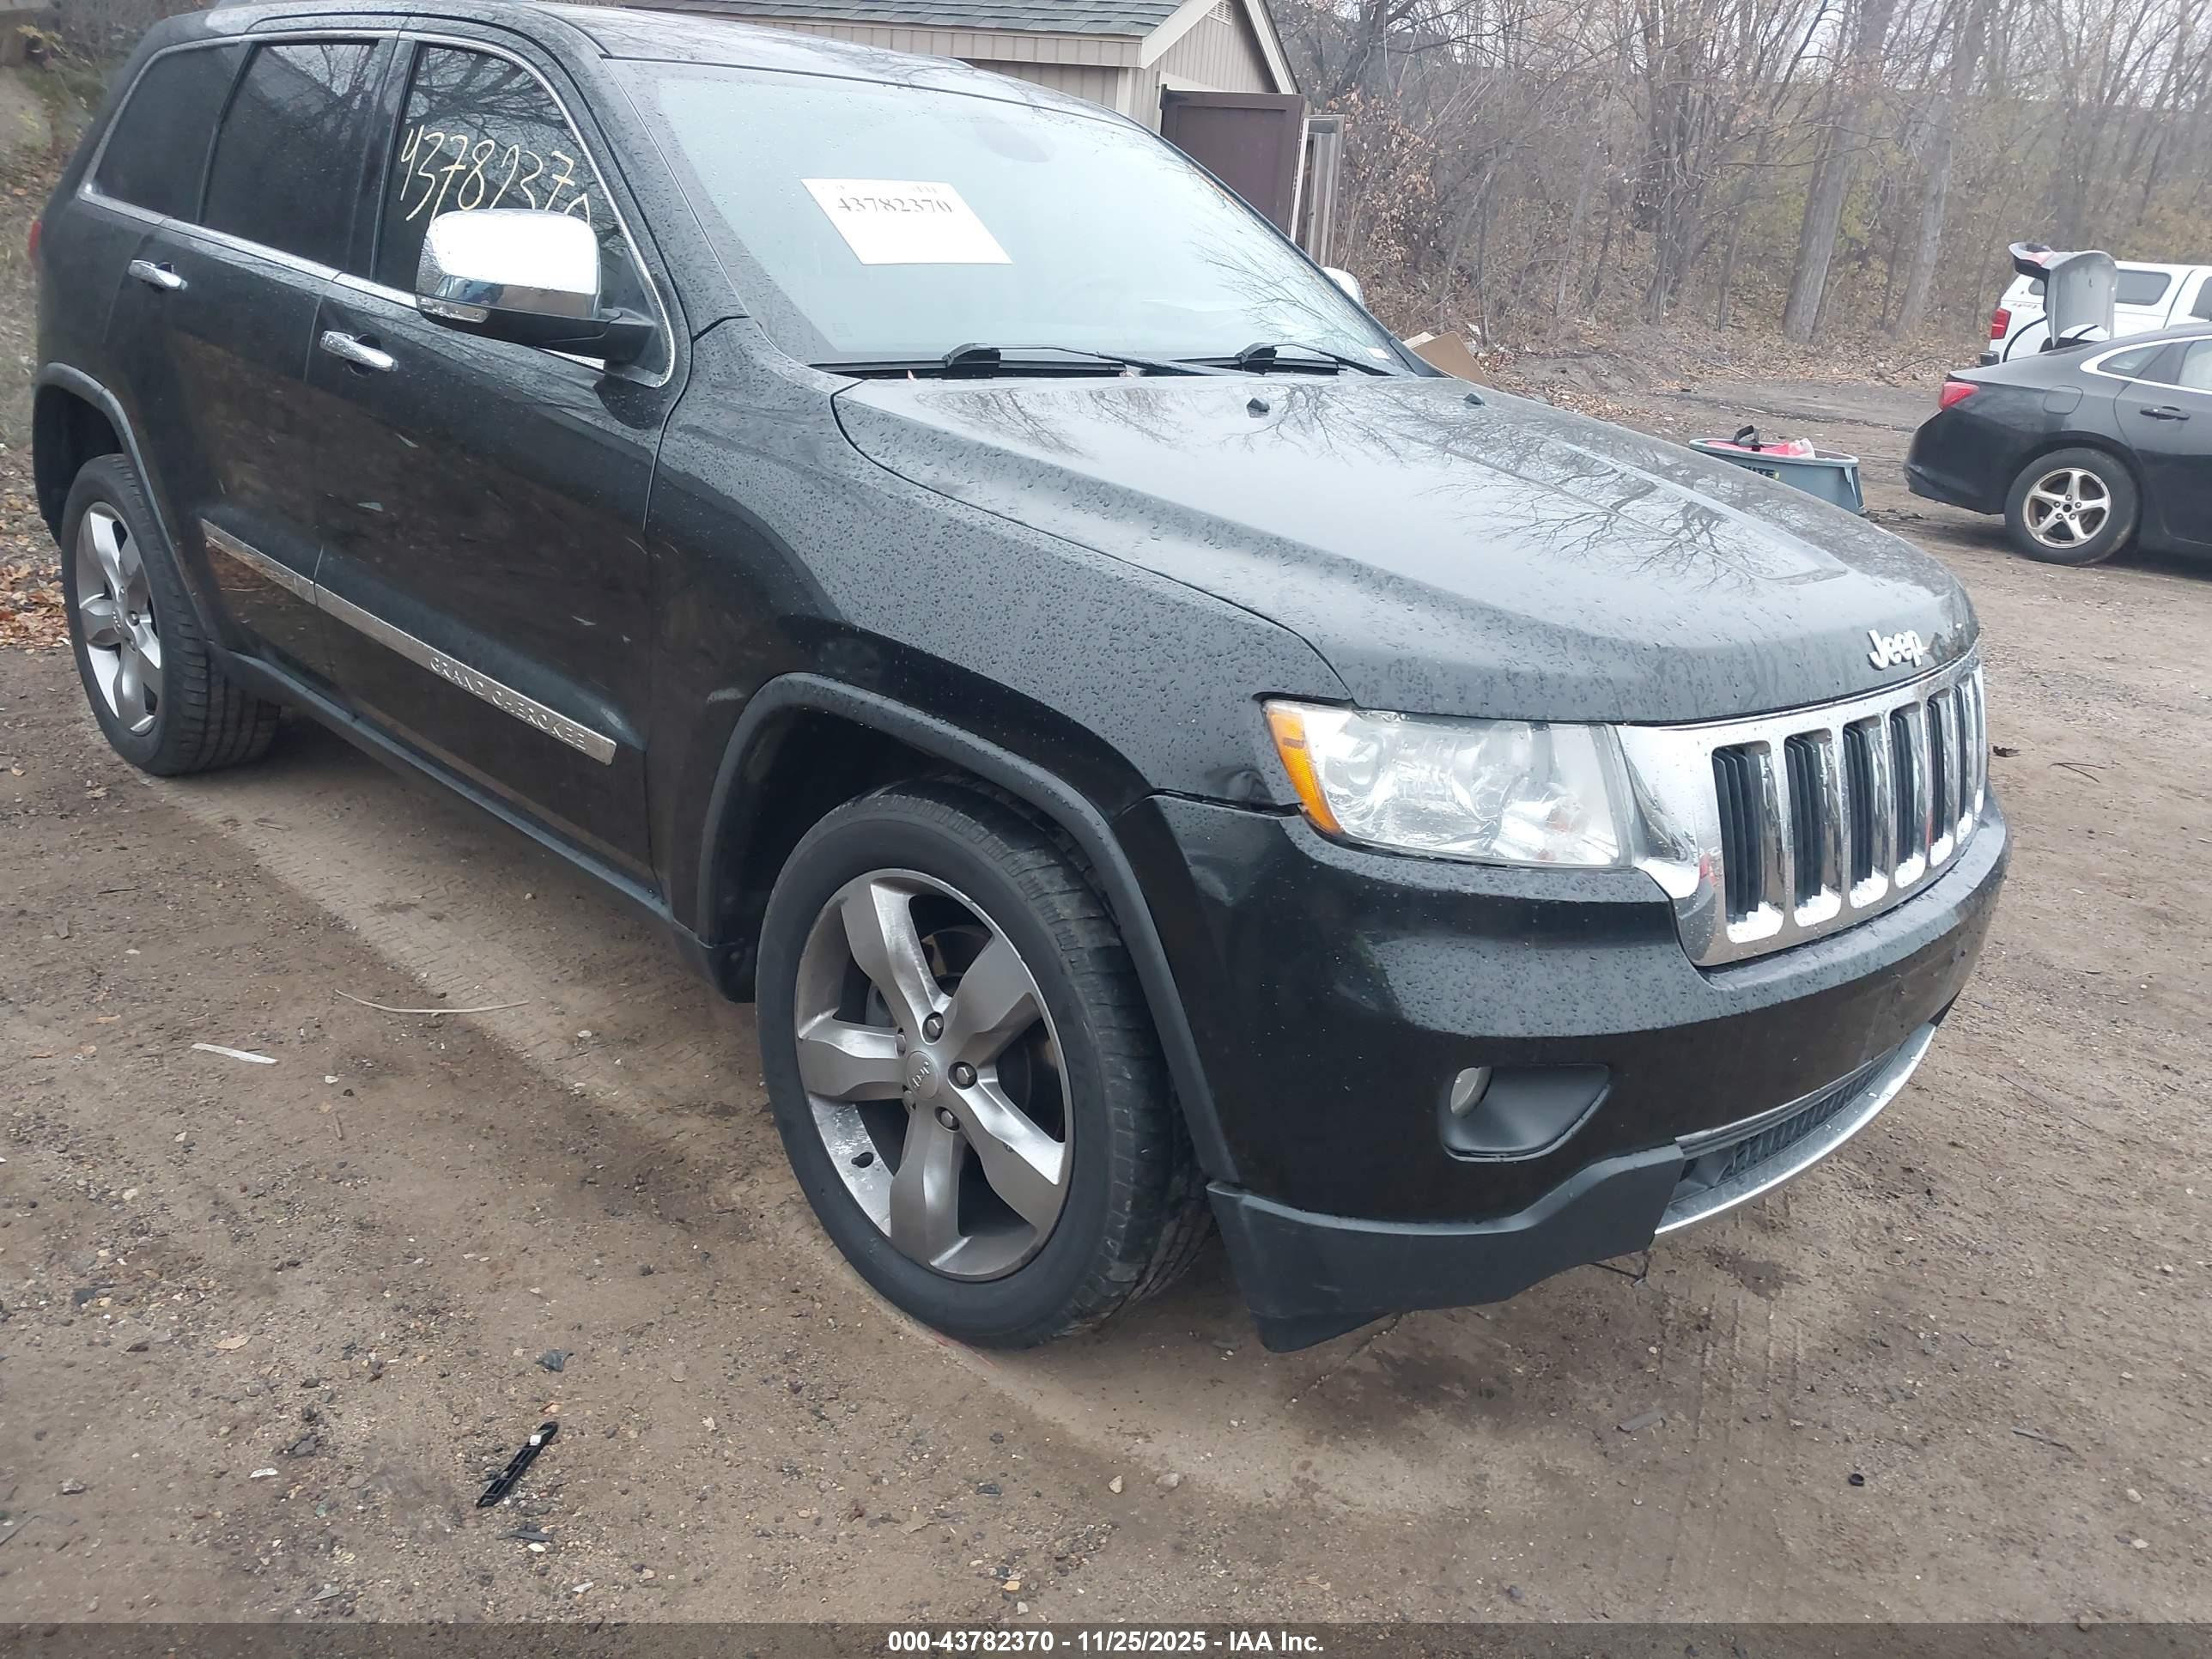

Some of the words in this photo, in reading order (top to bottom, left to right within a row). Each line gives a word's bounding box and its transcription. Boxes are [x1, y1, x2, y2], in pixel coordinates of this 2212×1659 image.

[837, 197, 954, 213] 43782370
[1867, 629, 1924, 671] Jeep
[429, 656, 486, 696] GRAND
[491, 690, 586, 751] CHEROKEE
